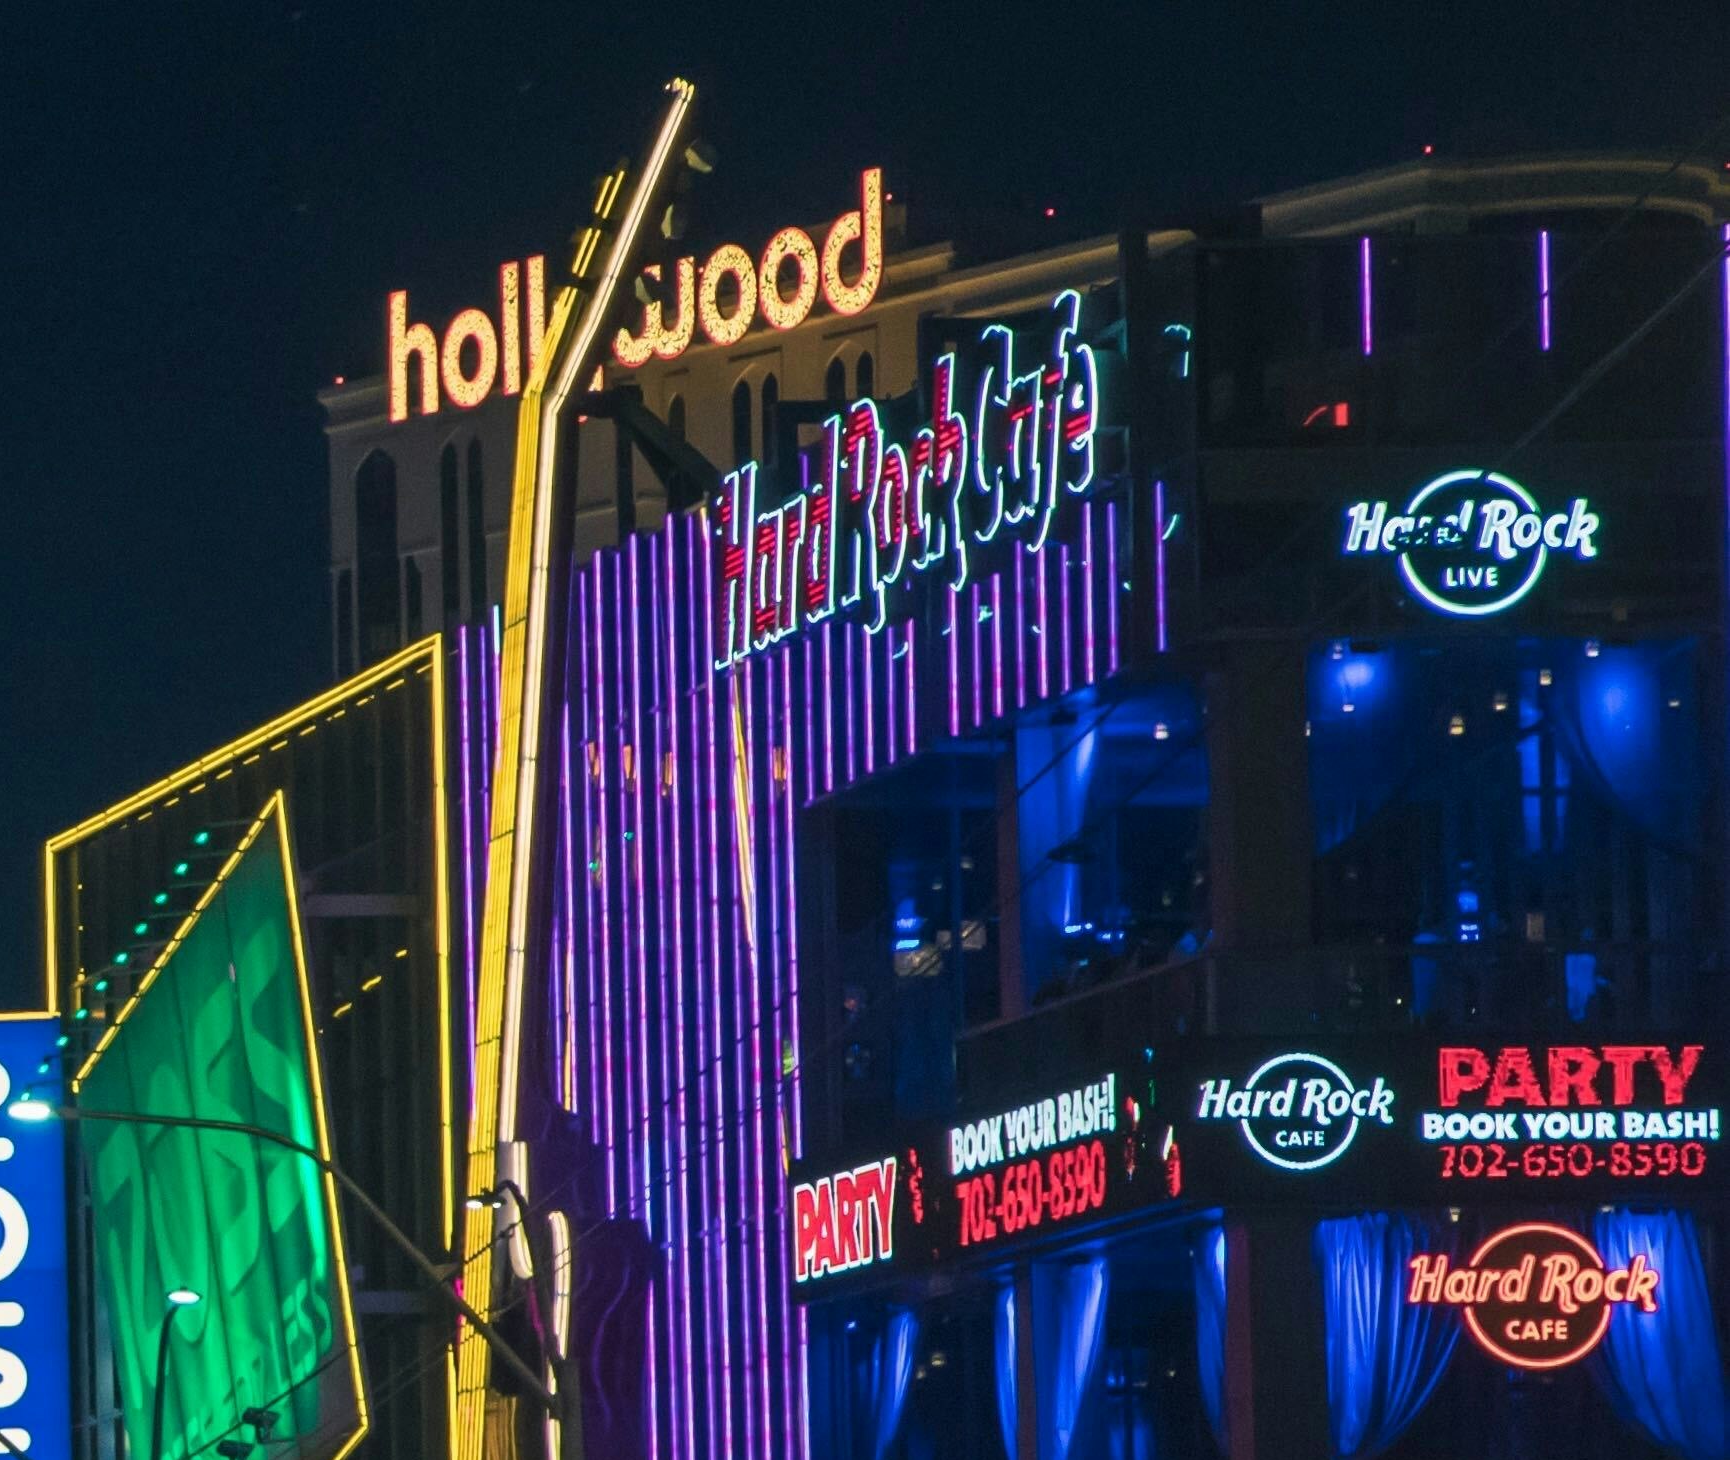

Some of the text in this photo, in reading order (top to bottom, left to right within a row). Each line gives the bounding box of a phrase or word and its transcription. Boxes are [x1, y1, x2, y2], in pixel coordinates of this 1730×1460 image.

[388, 167, 883, 423] hollwood
[715, 415, 841, 669] Hard
[841, 353, 967, 634] Rock
[1477, 498, 1600, 560] Rock
[1445, 566, 1500, 588] LIVE
[1197, 1077, 1396, 1125] Hard Rock
[1439, 1045, 1705, 1107] PARTY
[951, 1073, 1117, 1176] BOOK YOUR BASH!
[1274, 1129, 1327, 1148] CAFE
[1422, 1108, 1721, 1141] BOOK YOUR BASH!
[1440, 1143, 1708, 1178] 702-650-8590
[793, 1156, 898, 1284] PARTY
[955, 1139, 1108, 1247] 702-650-8590
[1407, 1254, 1661, 1313] Hard Rock
[1504, 1318, 1570, 1342] CAFE
